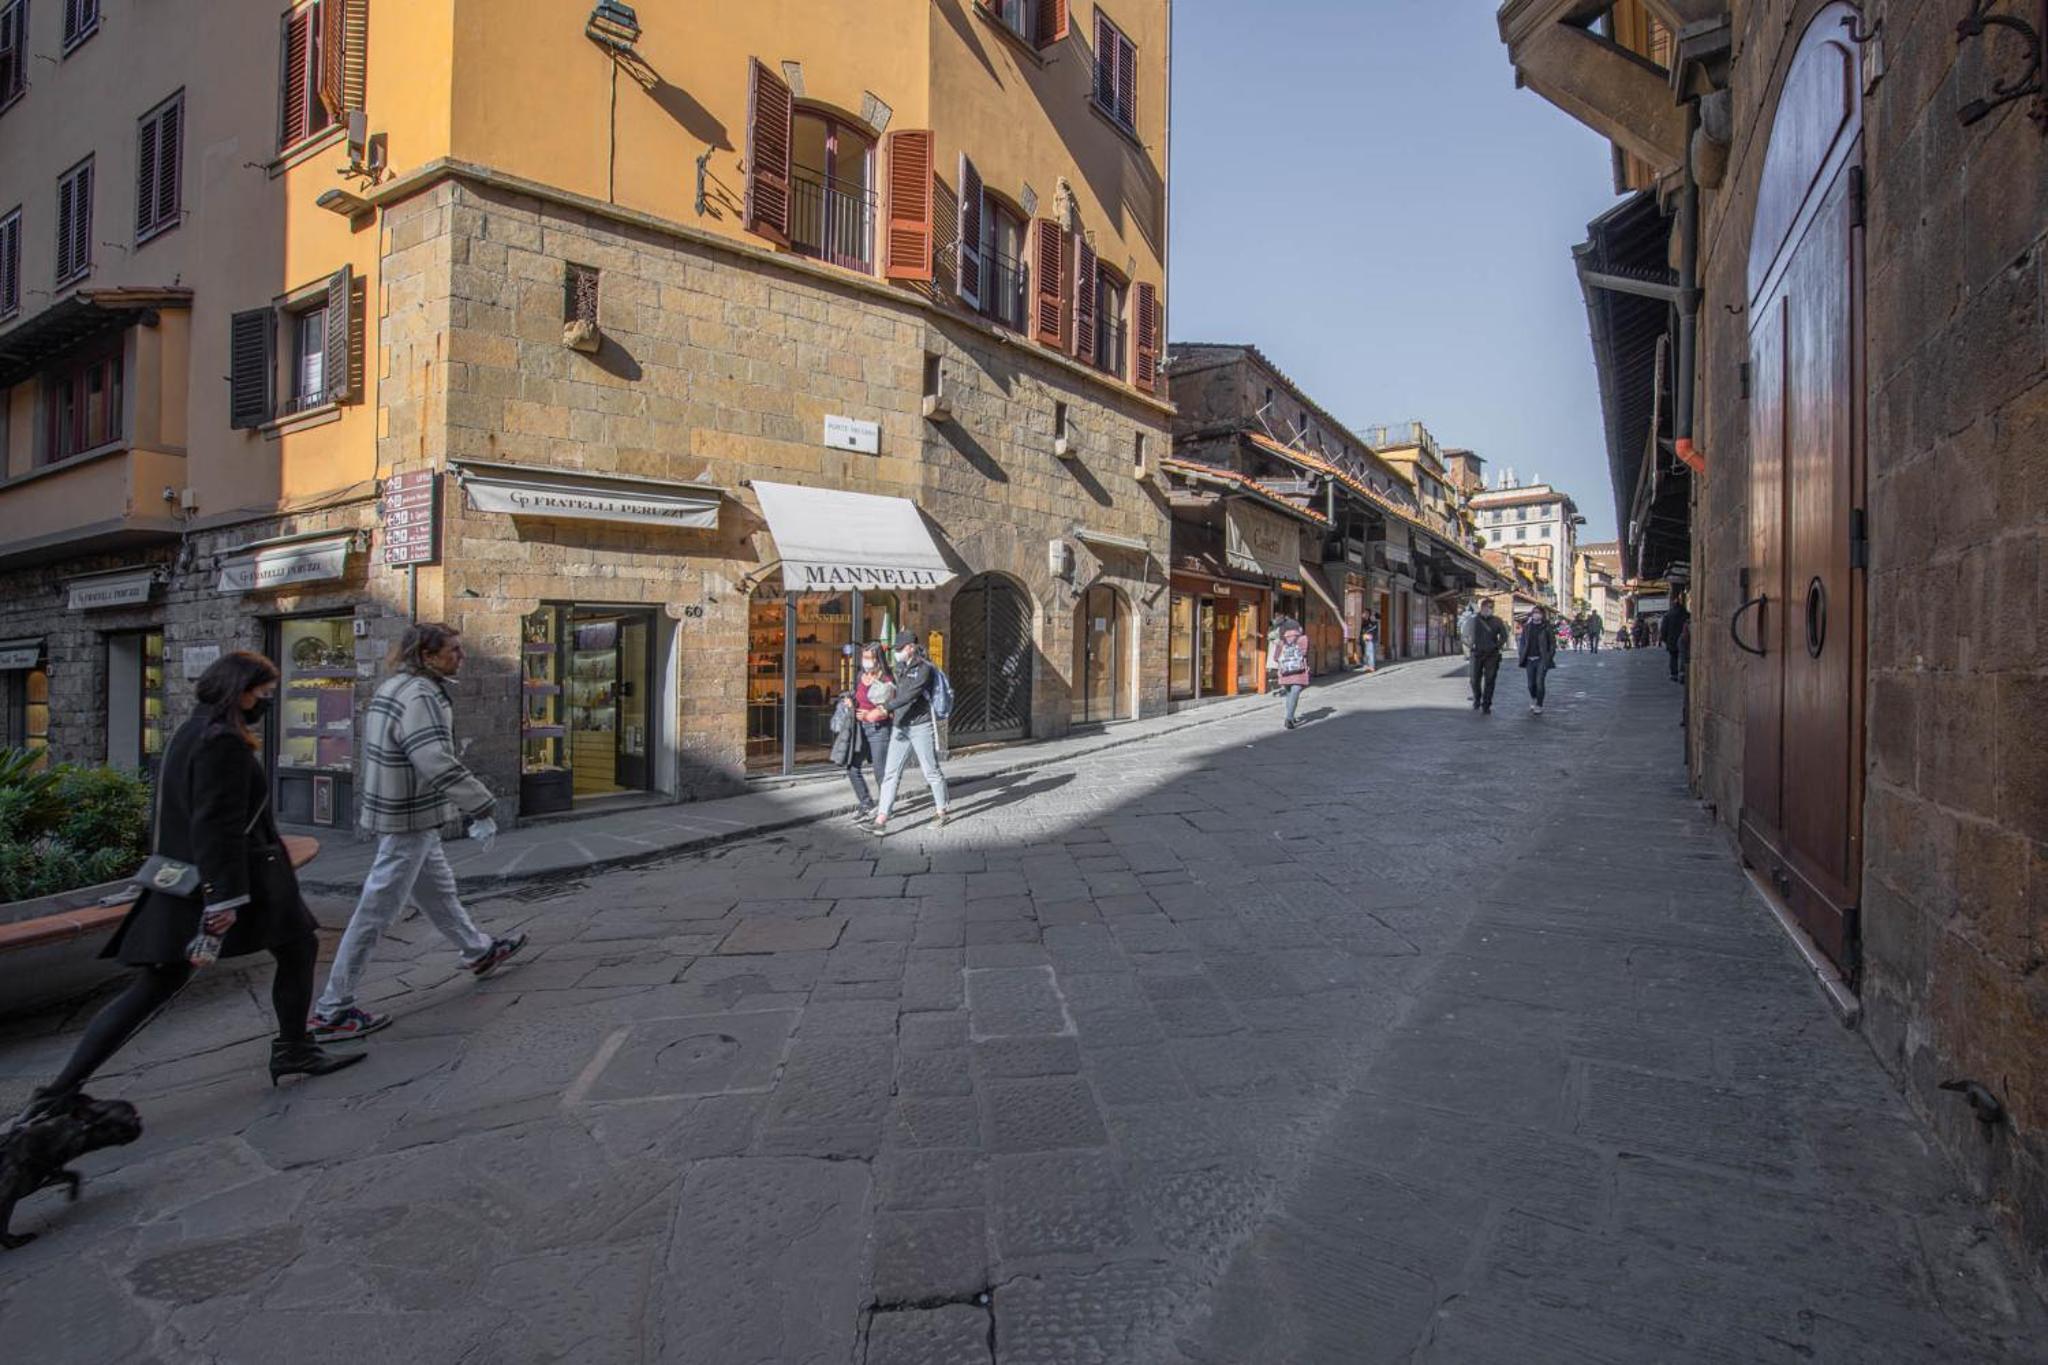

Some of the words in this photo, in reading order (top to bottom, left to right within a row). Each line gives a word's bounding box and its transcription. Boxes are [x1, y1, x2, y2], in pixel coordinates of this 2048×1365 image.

[534, 497, 614, 513] FRATELLI
[620, 503, 684, 519] PERUZZI
[806, 565, 937, 586] MANNELLI
[684, 605, 703, 618] 60
